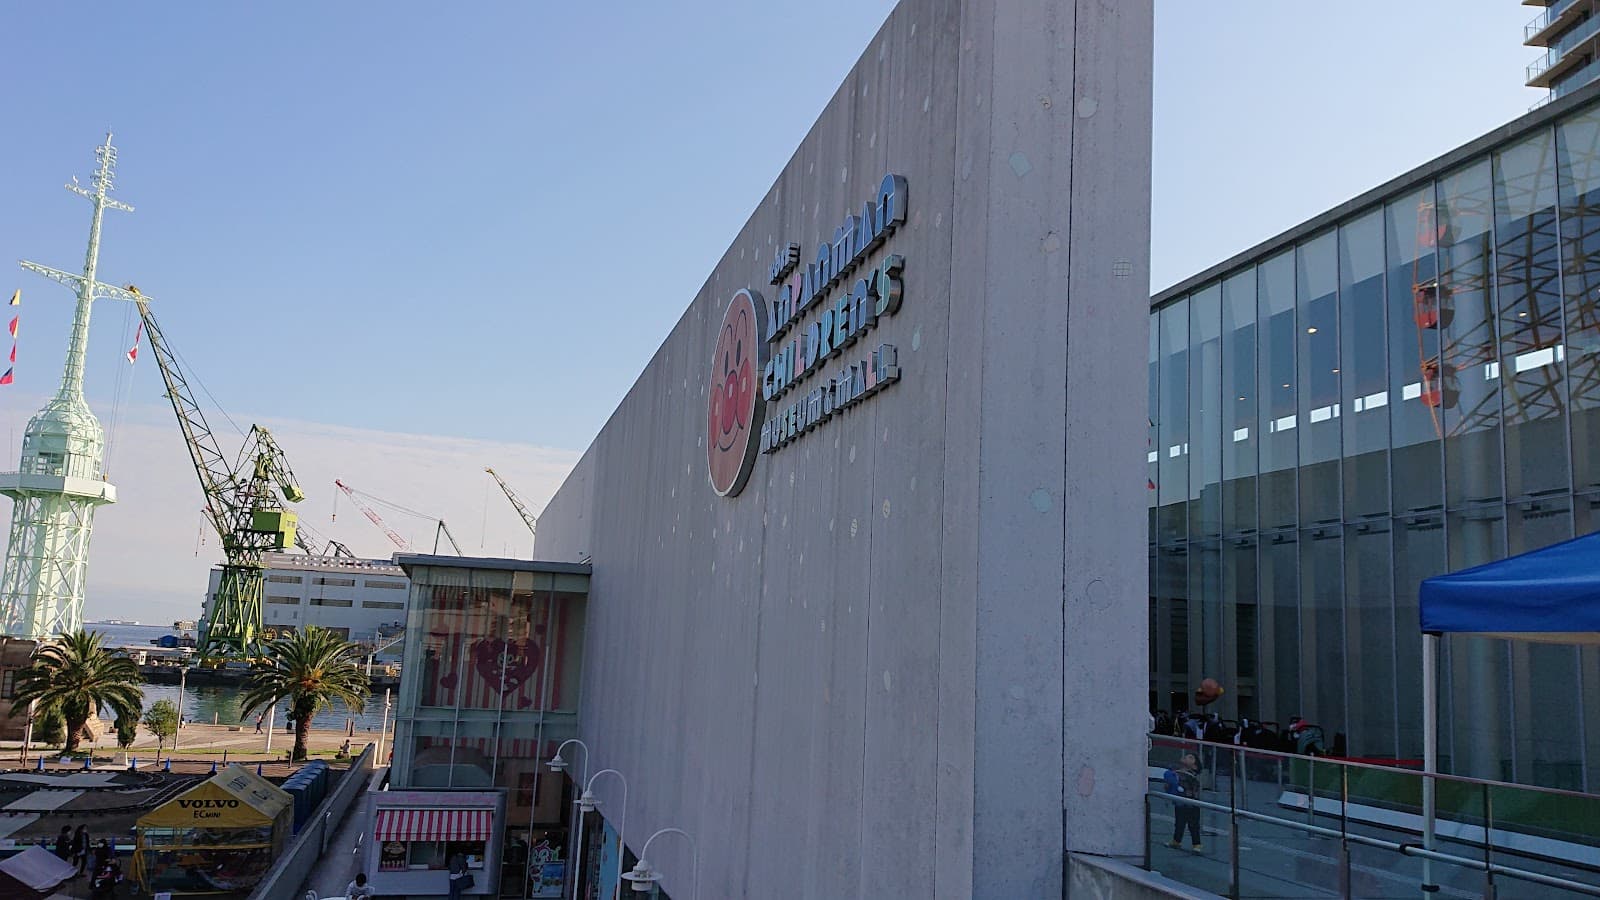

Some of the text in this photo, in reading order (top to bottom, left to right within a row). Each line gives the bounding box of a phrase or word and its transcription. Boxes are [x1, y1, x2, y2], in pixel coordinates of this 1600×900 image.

[765, 173, 907, 343] ANPANMAN
[762, 254, 905, 402] CHILDREN'S
[760, 344, 898, 454] MUSEUM & MALL
[177, 799, 239, 809] VOLVO
